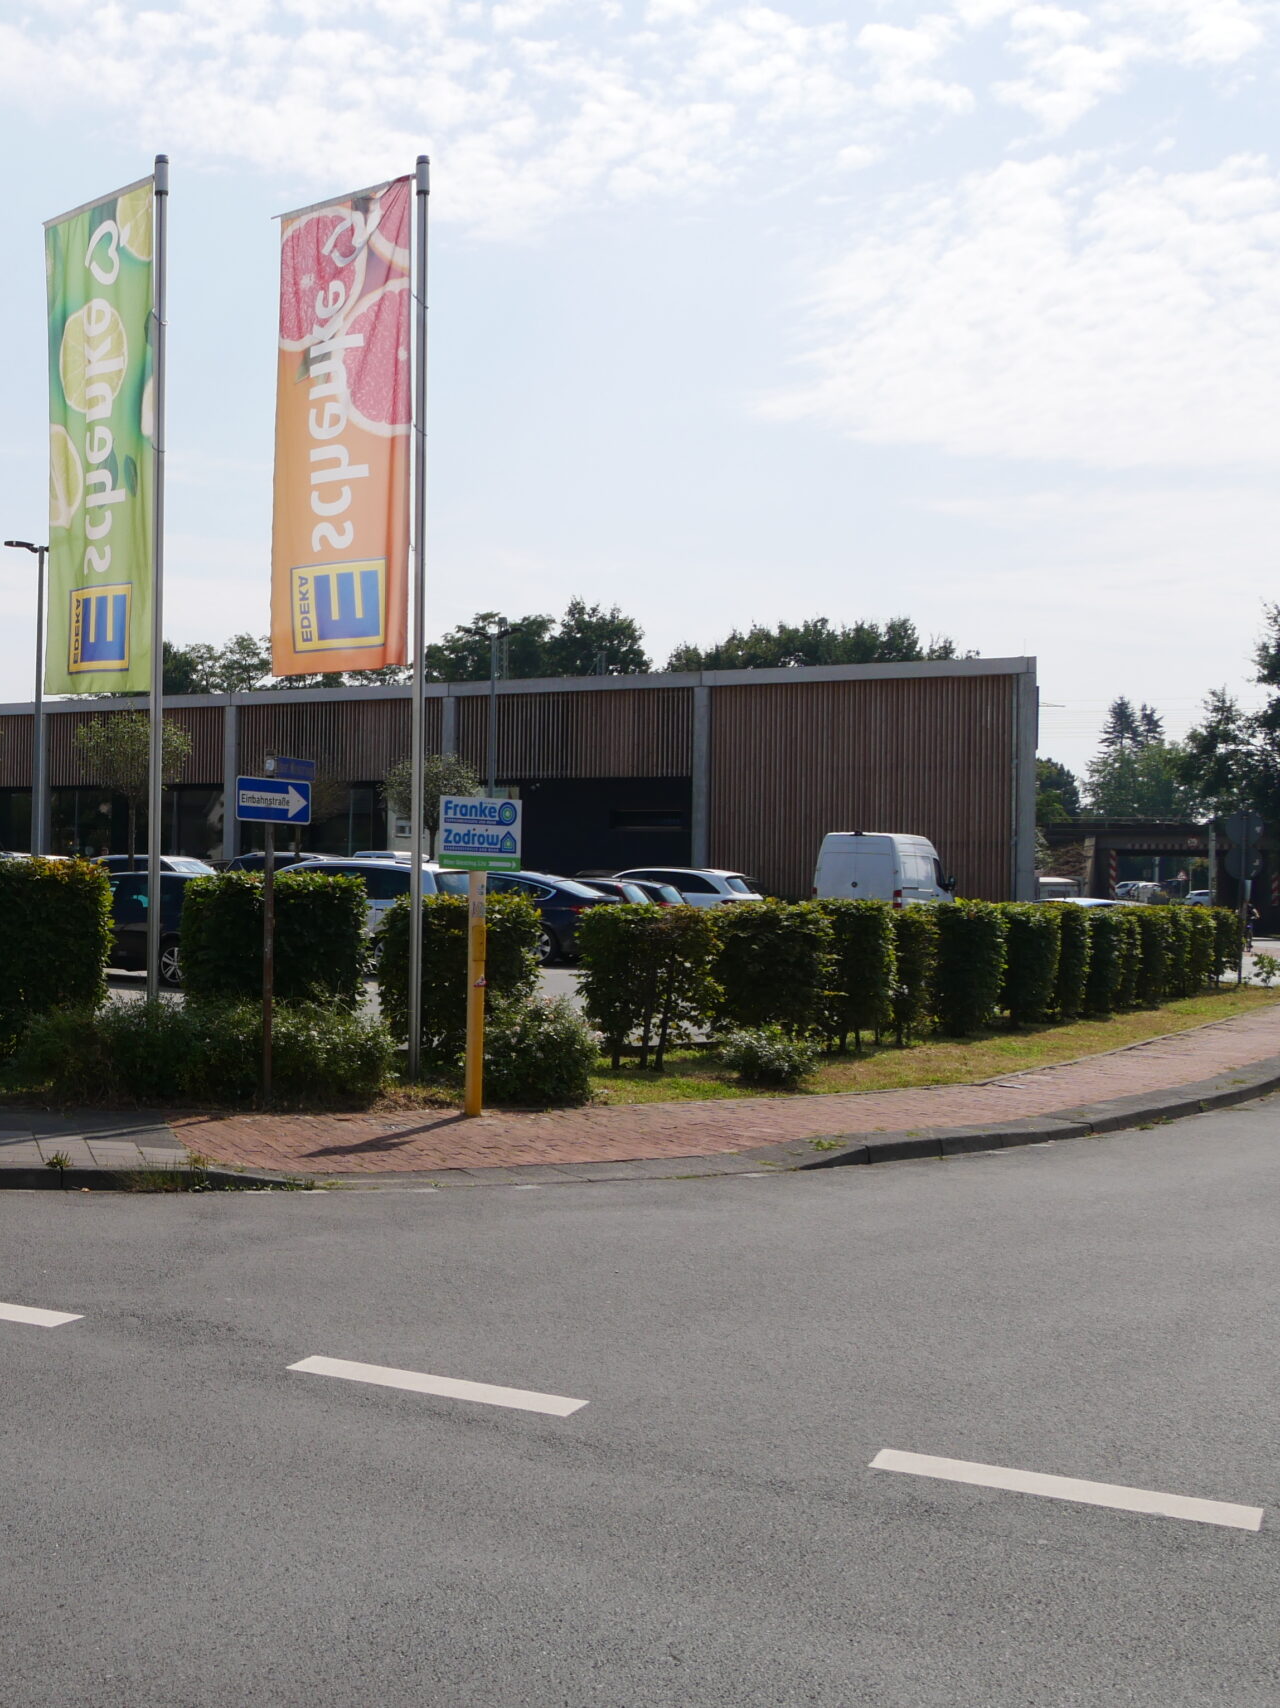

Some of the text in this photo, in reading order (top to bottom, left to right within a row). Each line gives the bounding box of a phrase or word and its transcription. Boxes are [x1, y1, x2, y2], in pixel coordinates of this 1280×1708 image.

[241, 793, 290, 807] Einbahnstraße
[444, 800, 497, 818] Franke
[443, 829, 499, 846] Zodrow
